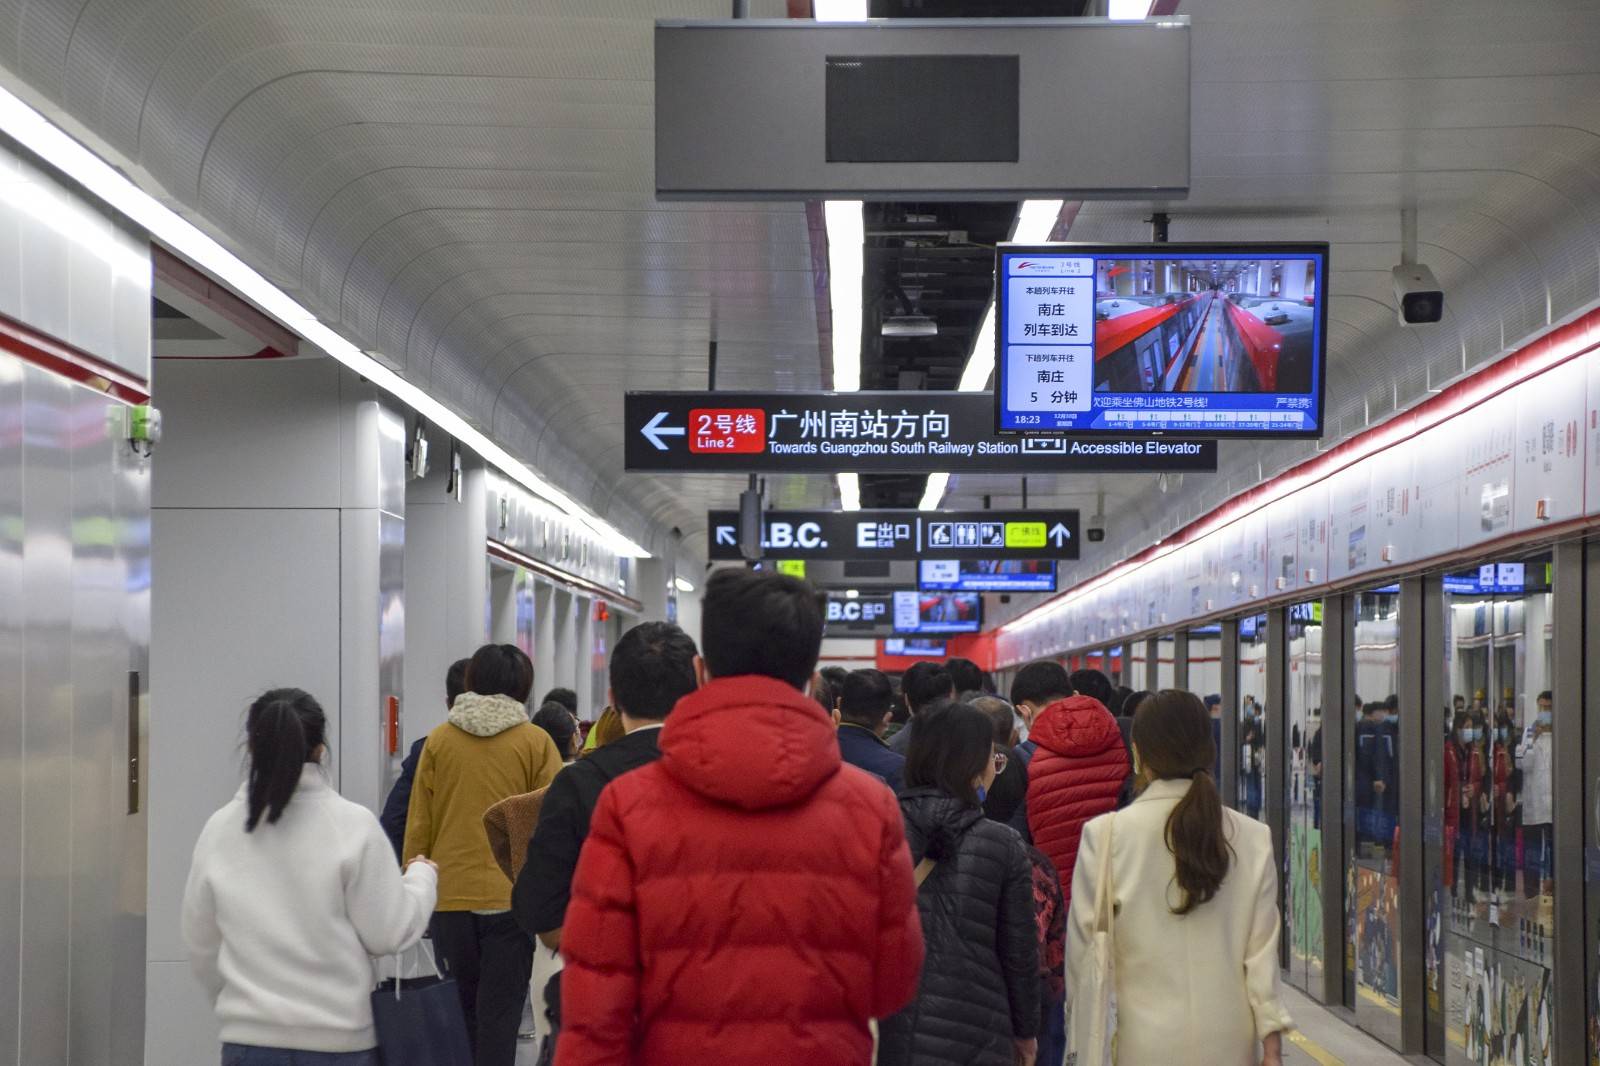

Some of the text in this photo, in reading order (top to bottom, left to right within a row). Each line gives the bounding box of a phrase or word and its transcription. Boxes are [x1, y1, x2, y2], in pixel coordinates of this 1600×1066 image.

[1026, 286, 1075, 295] 本趟列车开往
[1038, 303, 1065, 317] 南庄
[1024, 323, 1078, 337] 列车到达
[1026, 354, 1075, 363] 下趟列车开往
[1037, 370, 1064, 383] 南庄
[1030, 390, 1078, 404] 5 分钟
[1275, 397, 1313, 409] 严禁携
[697, 414, 757, 434] 2号线
[768, 409, 950, 439] 广州南站方向
[1015, 415, 1041, 424] 18:23
[697, 437, 735, 448] Line 2
[769, 441, 1018, 457] Towards Guangzhou South Railway Station
[1070, 442, 1202, 454] Accessible Elevator
[760, 522, 828, 549] .B.C.
